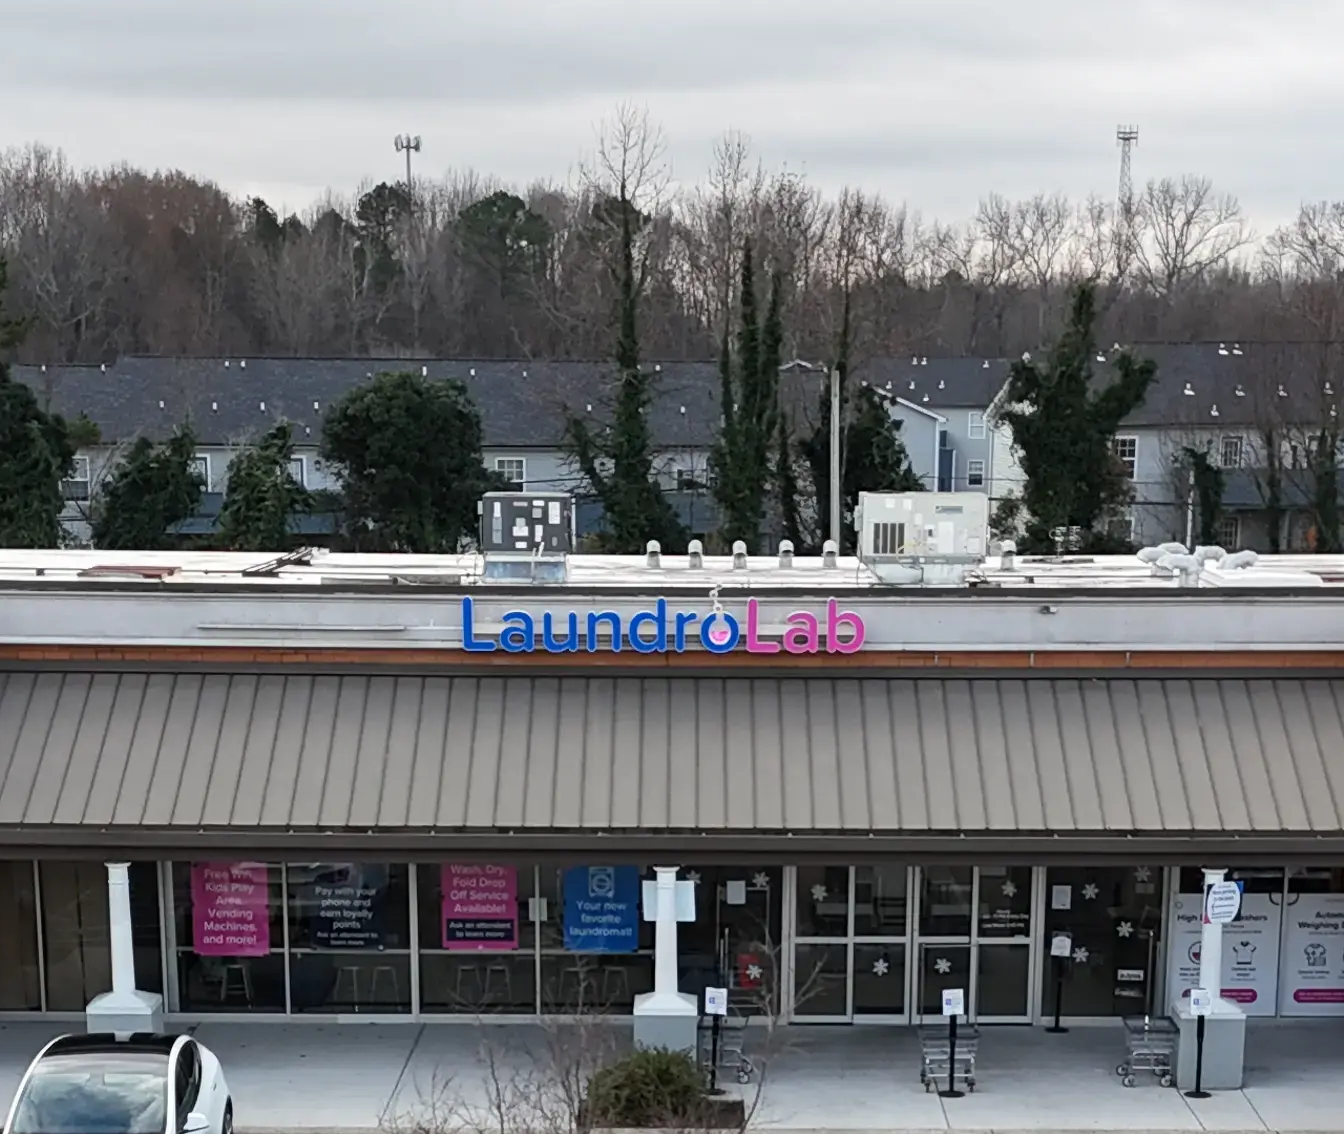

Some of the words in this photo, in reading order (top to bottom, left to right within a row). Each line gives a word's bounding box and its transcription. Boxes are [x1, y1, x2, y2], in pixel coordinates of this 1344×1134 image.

[460, 596, 865, 654] LaundroLab
[452, 877, 477, 888] Fold
[478, 877, 506, 888] Drop
[231, 883, 255, 895] Play
[449, 890, 468, 901] Off
[469, 890, 510, 901] Service
[320, 898, 351, 909] phone
[353, 899, 371, 907] and
[453, 903, 507, 914] Available!
[576, 900, 602, 911] Your
[207, 907, 254, 920] Vending
[580, 913, 622, 924] favorite
[1176, 913, 1198, 924] High
[1297, 920, 1340, 931] Weighing
[202, 934, 224, 945] and
[225, 935, 257, 945] more!
